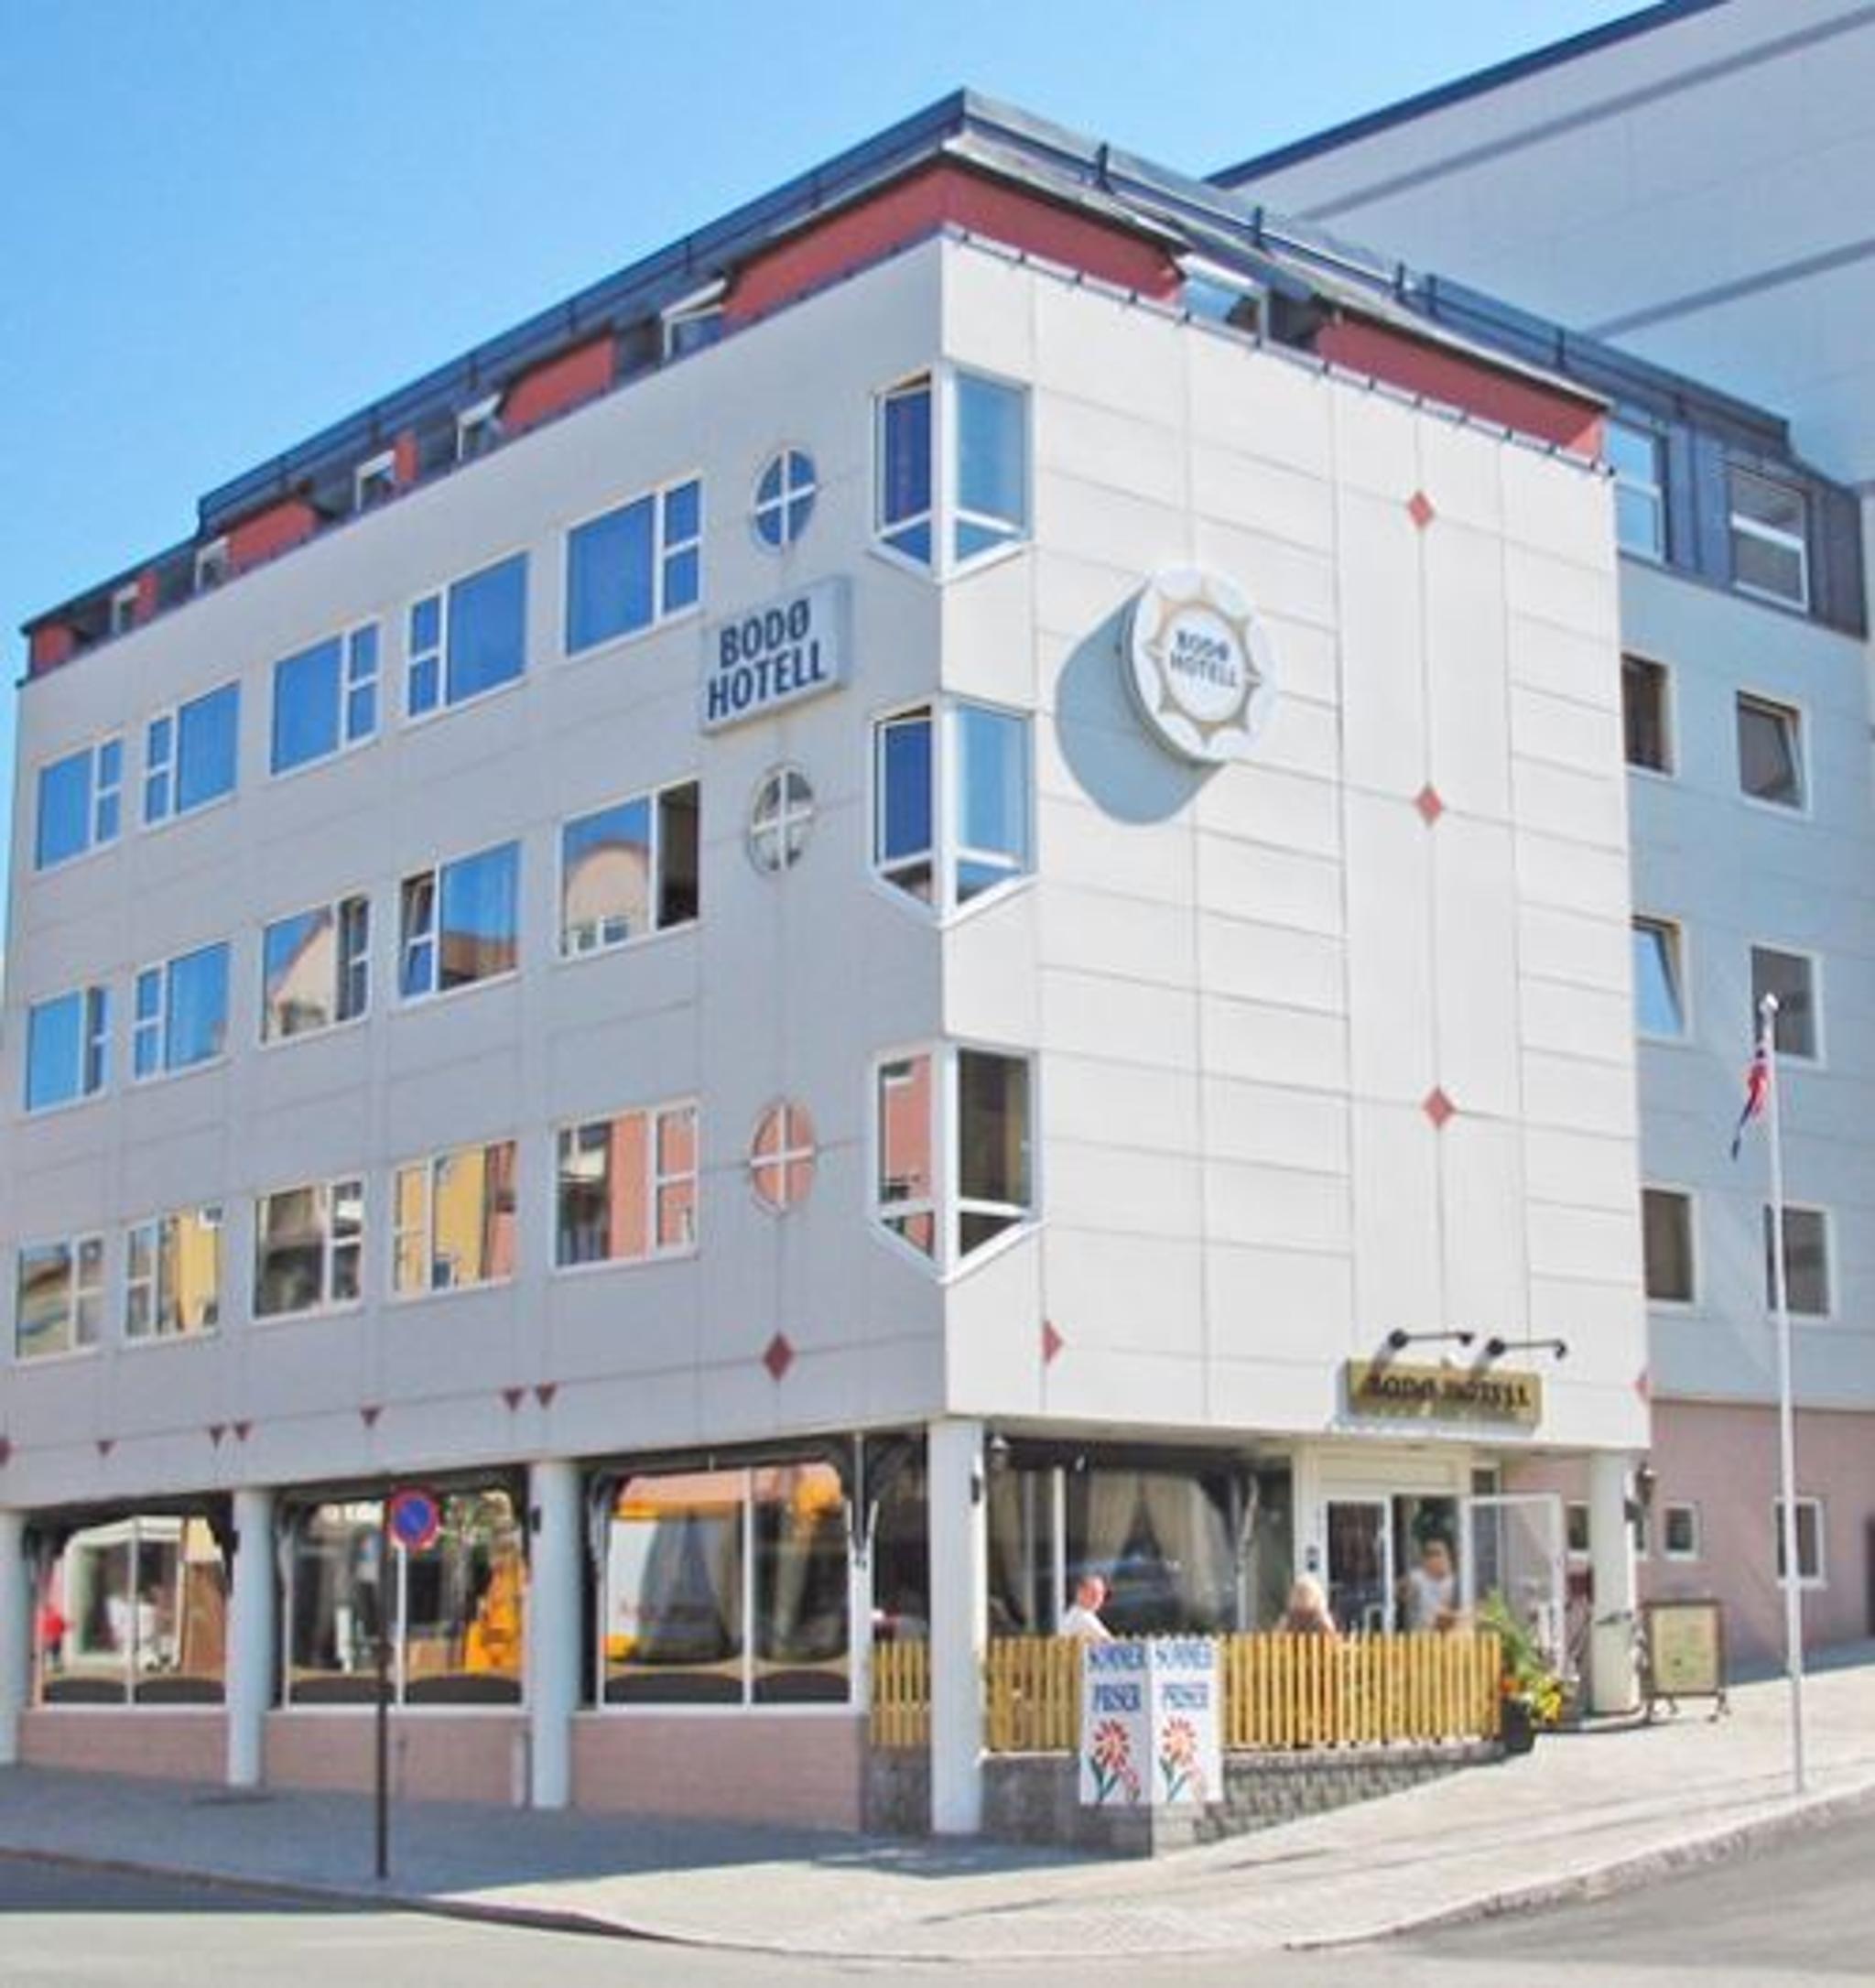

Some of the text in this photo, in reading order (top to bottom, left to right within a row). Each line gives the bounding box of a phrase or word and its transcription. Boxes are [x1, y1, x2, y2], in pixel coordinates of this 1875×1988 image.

[720, 598, 810, 668] BODØ
[708, 639, 826, 720] HOTELL
[1170, 651, 1238, 687] HOTELL
[1088, 1643, 1144, 1669] SOMMER
